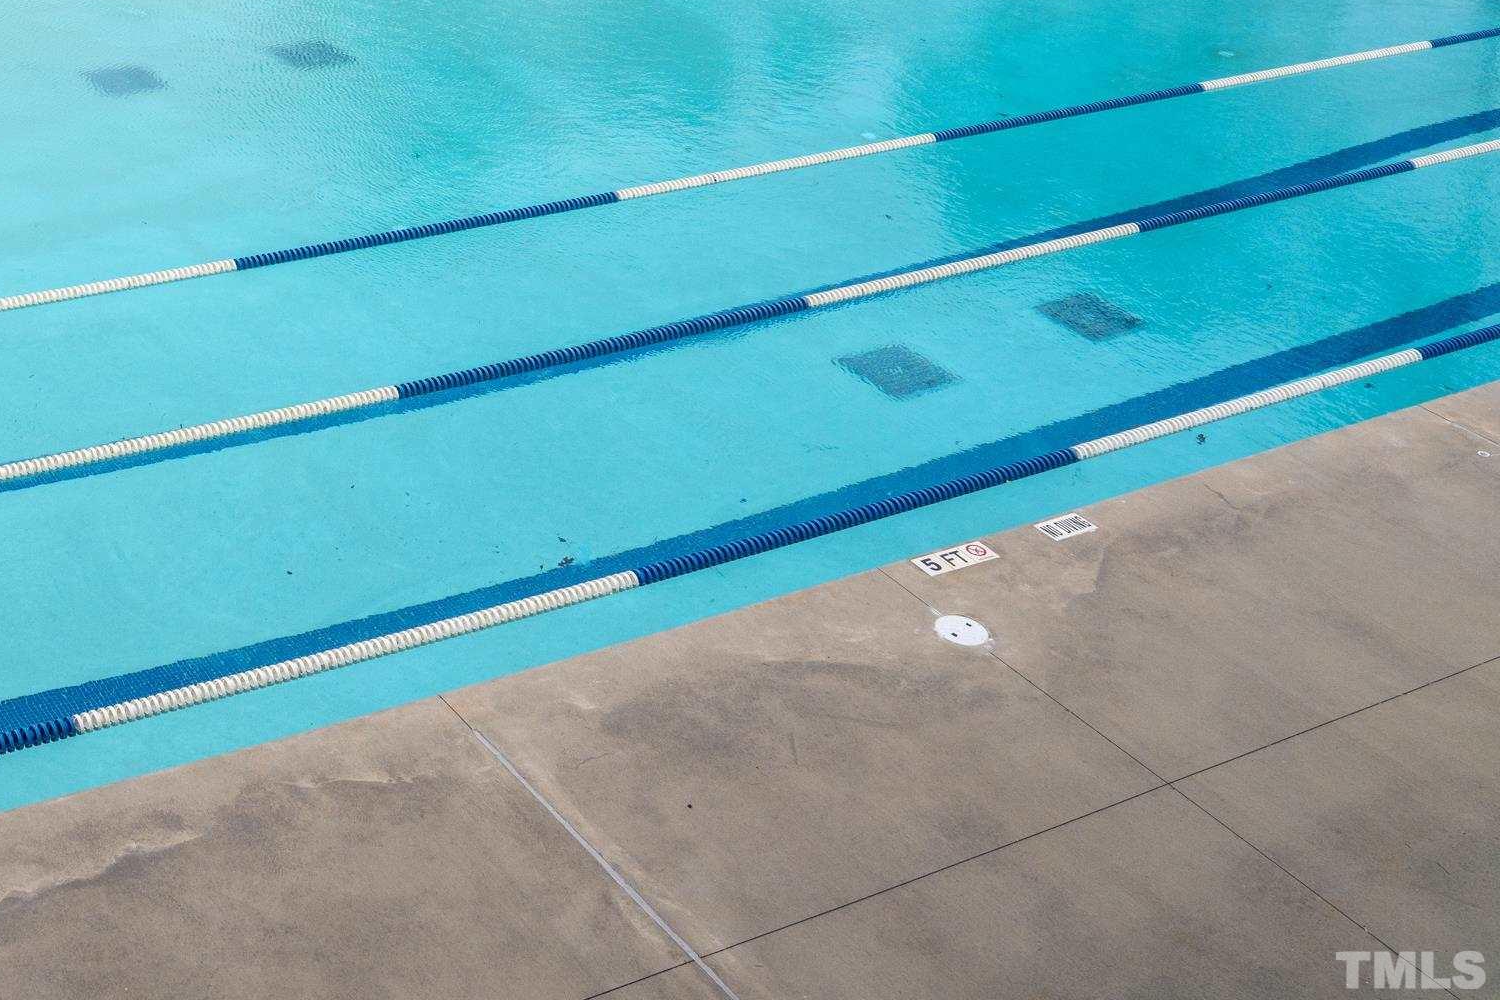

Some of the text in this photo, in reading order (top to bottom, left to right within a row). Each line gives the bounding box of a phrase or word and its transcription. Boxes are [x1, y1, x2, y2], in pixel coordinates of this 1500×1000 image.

[1039, 516, 1092, 538] NO DIVING
[920, 550, 968, 572] 5 FT
